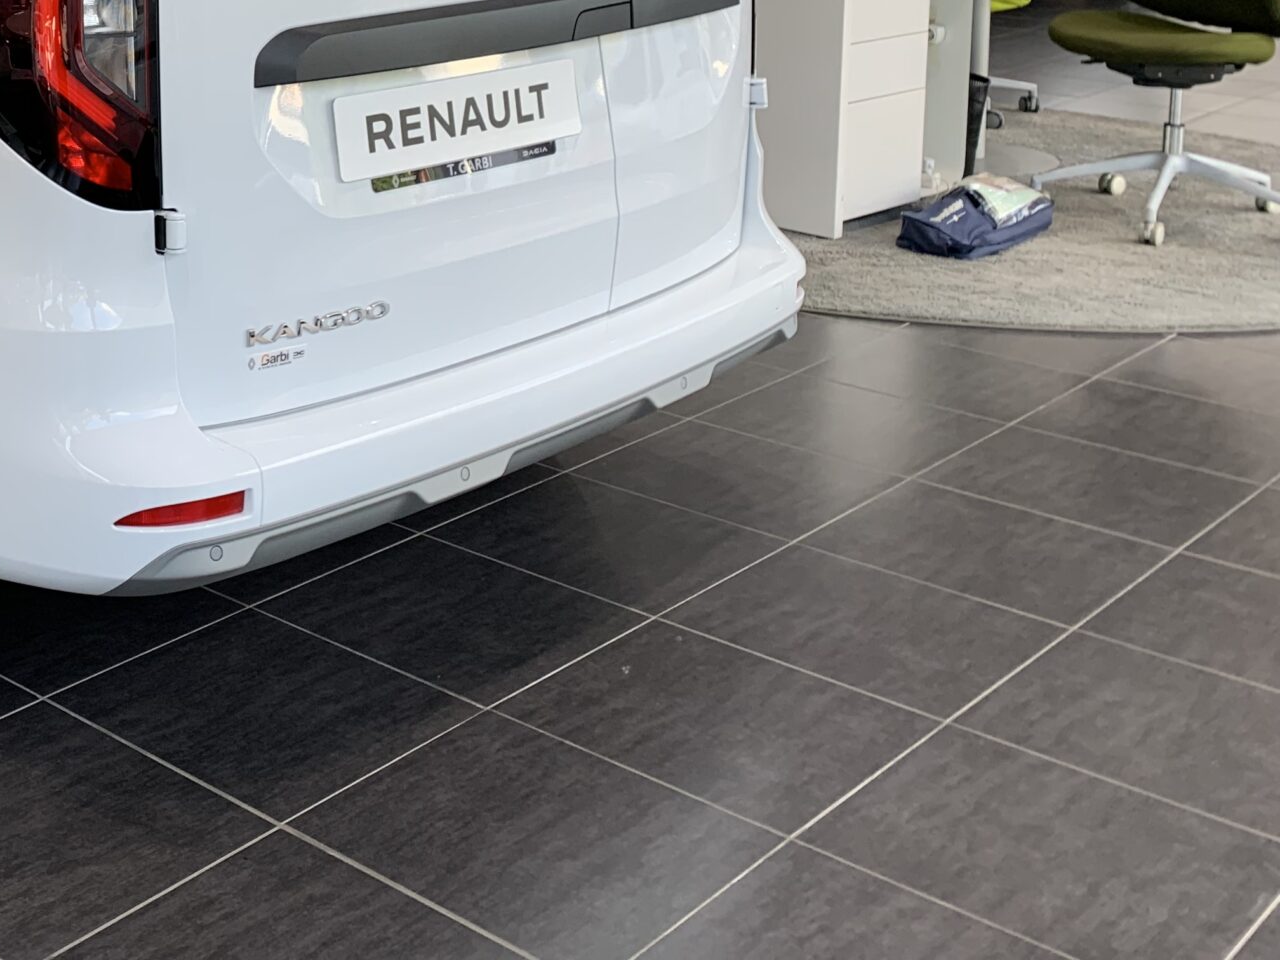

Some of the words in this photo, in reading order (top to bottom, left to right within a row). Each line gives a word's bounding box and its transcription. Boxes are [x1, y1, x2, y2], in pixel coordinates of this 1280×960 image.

[365, 82, 549, 154] RENAULT
[246, 300, 391, 347] KANGOO
[260, 350, 290, 367] Garbi
